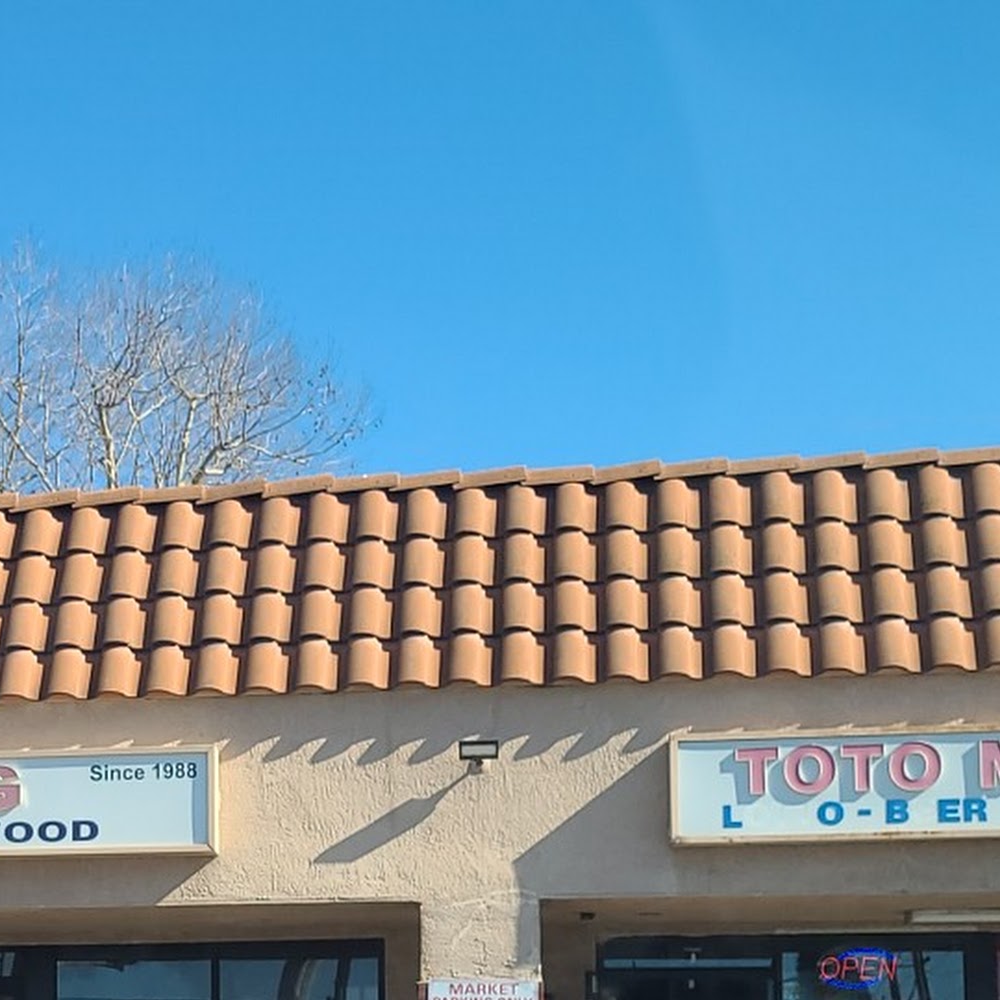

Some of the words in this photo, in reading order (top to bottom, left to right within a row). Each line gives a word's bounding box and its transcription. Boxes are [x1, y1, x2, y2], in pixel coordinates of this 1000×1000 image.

[89, 765, 145, 782] Since
[154, 763, 198, 780] 1988
[734, 741, 941, 796] TOTO
[818, 955, 898, 981] OPEN
[449, 983, 519, 995] MARKET
